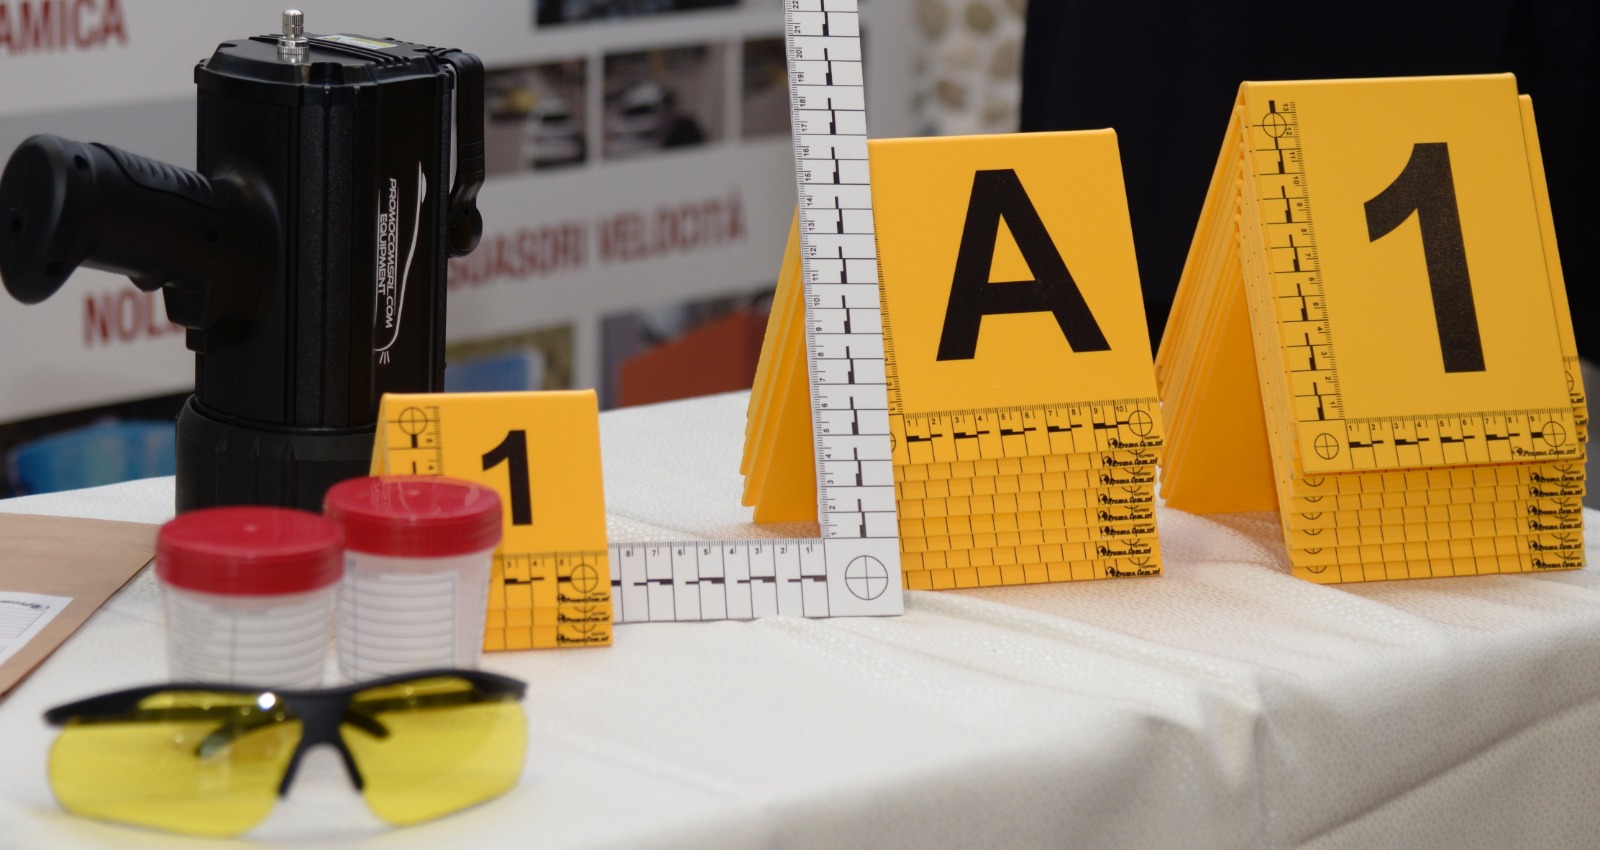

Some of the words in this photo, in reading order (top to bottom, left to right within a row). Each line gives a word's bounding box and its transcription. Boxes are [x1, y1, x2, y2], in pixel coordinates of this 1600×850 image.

[793, 0, 799, 9] 22
[796, 50, 802, 58] 20
[800, 99, 806, 107] 18
[801, 124, 808, 132] 17
[1282, 103, 1290, 112] 13
[1286, 127, 1292, 136] 12
[1293, 176, 1300, 184] 10
[805, 173, 811, 181] 15
[807, 198, 813, 206] 14
[809, 223, 815, 231] 13
[378, 213, 388, 295] EQUIPMENT
[386, 178, 396, 328] PROMOCOMSRL.COM
[810, 248, 816, 256] 12
[1363, 142, 1486, 373] 1
[936, 169, 1112, 361] A
[814, 298, 820, 306] 10
[84, 290, 187, 347] NOL
[482, 429, 533, 526] 1
